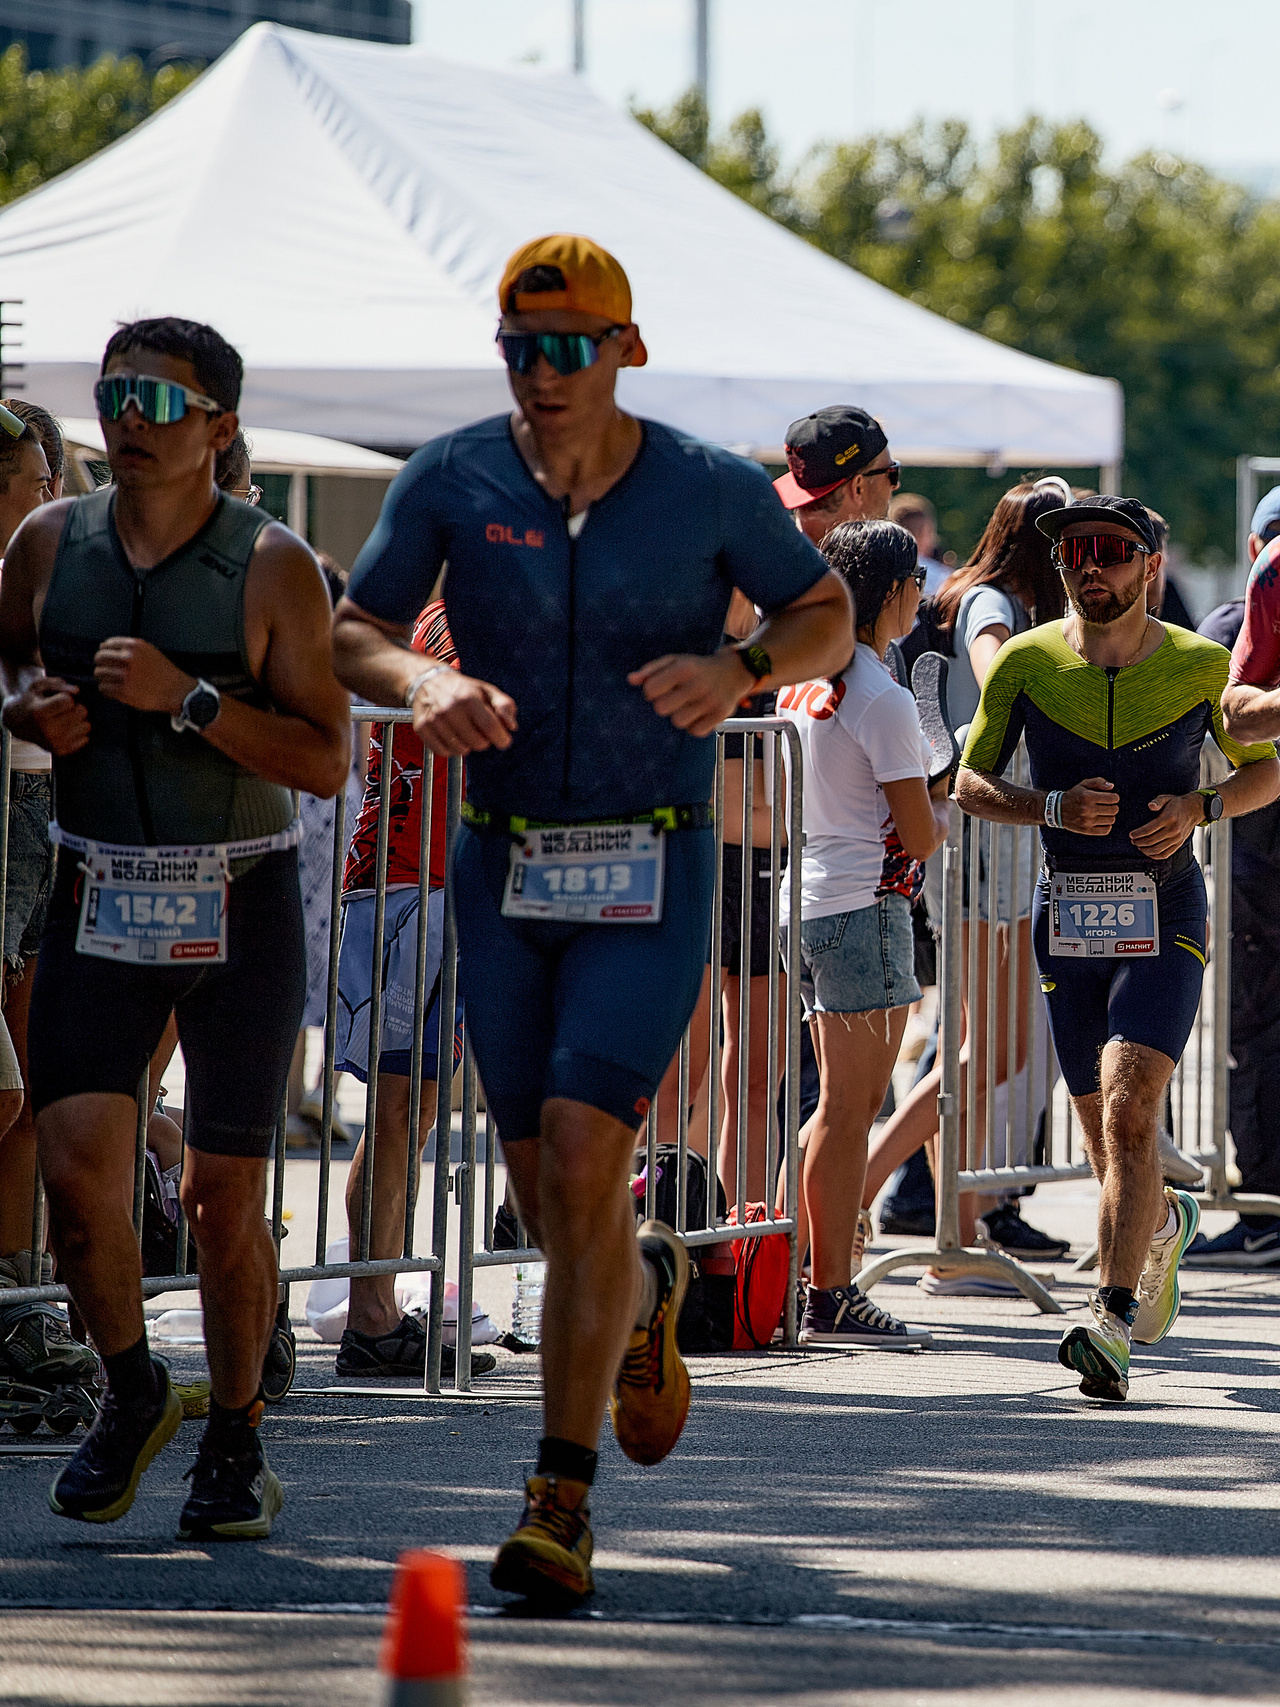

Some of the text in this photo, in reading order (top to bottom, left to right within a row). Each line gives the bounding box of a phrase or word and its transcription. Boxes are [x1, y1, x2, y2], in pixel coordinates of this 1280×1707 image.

[543, 863, 631, 893] 1813
[1066, 874, 1134, 884] МЕДНЫЙ
[1066, 884, 1134, 893] ВСАДНИК
[114, 894, 196, 925] 1542
[1069, 903, 1135, 926] 1226
[183, 945, 216, 954] МАГНИТ
[1125, 942, 1151, 950] МАГНИТ
